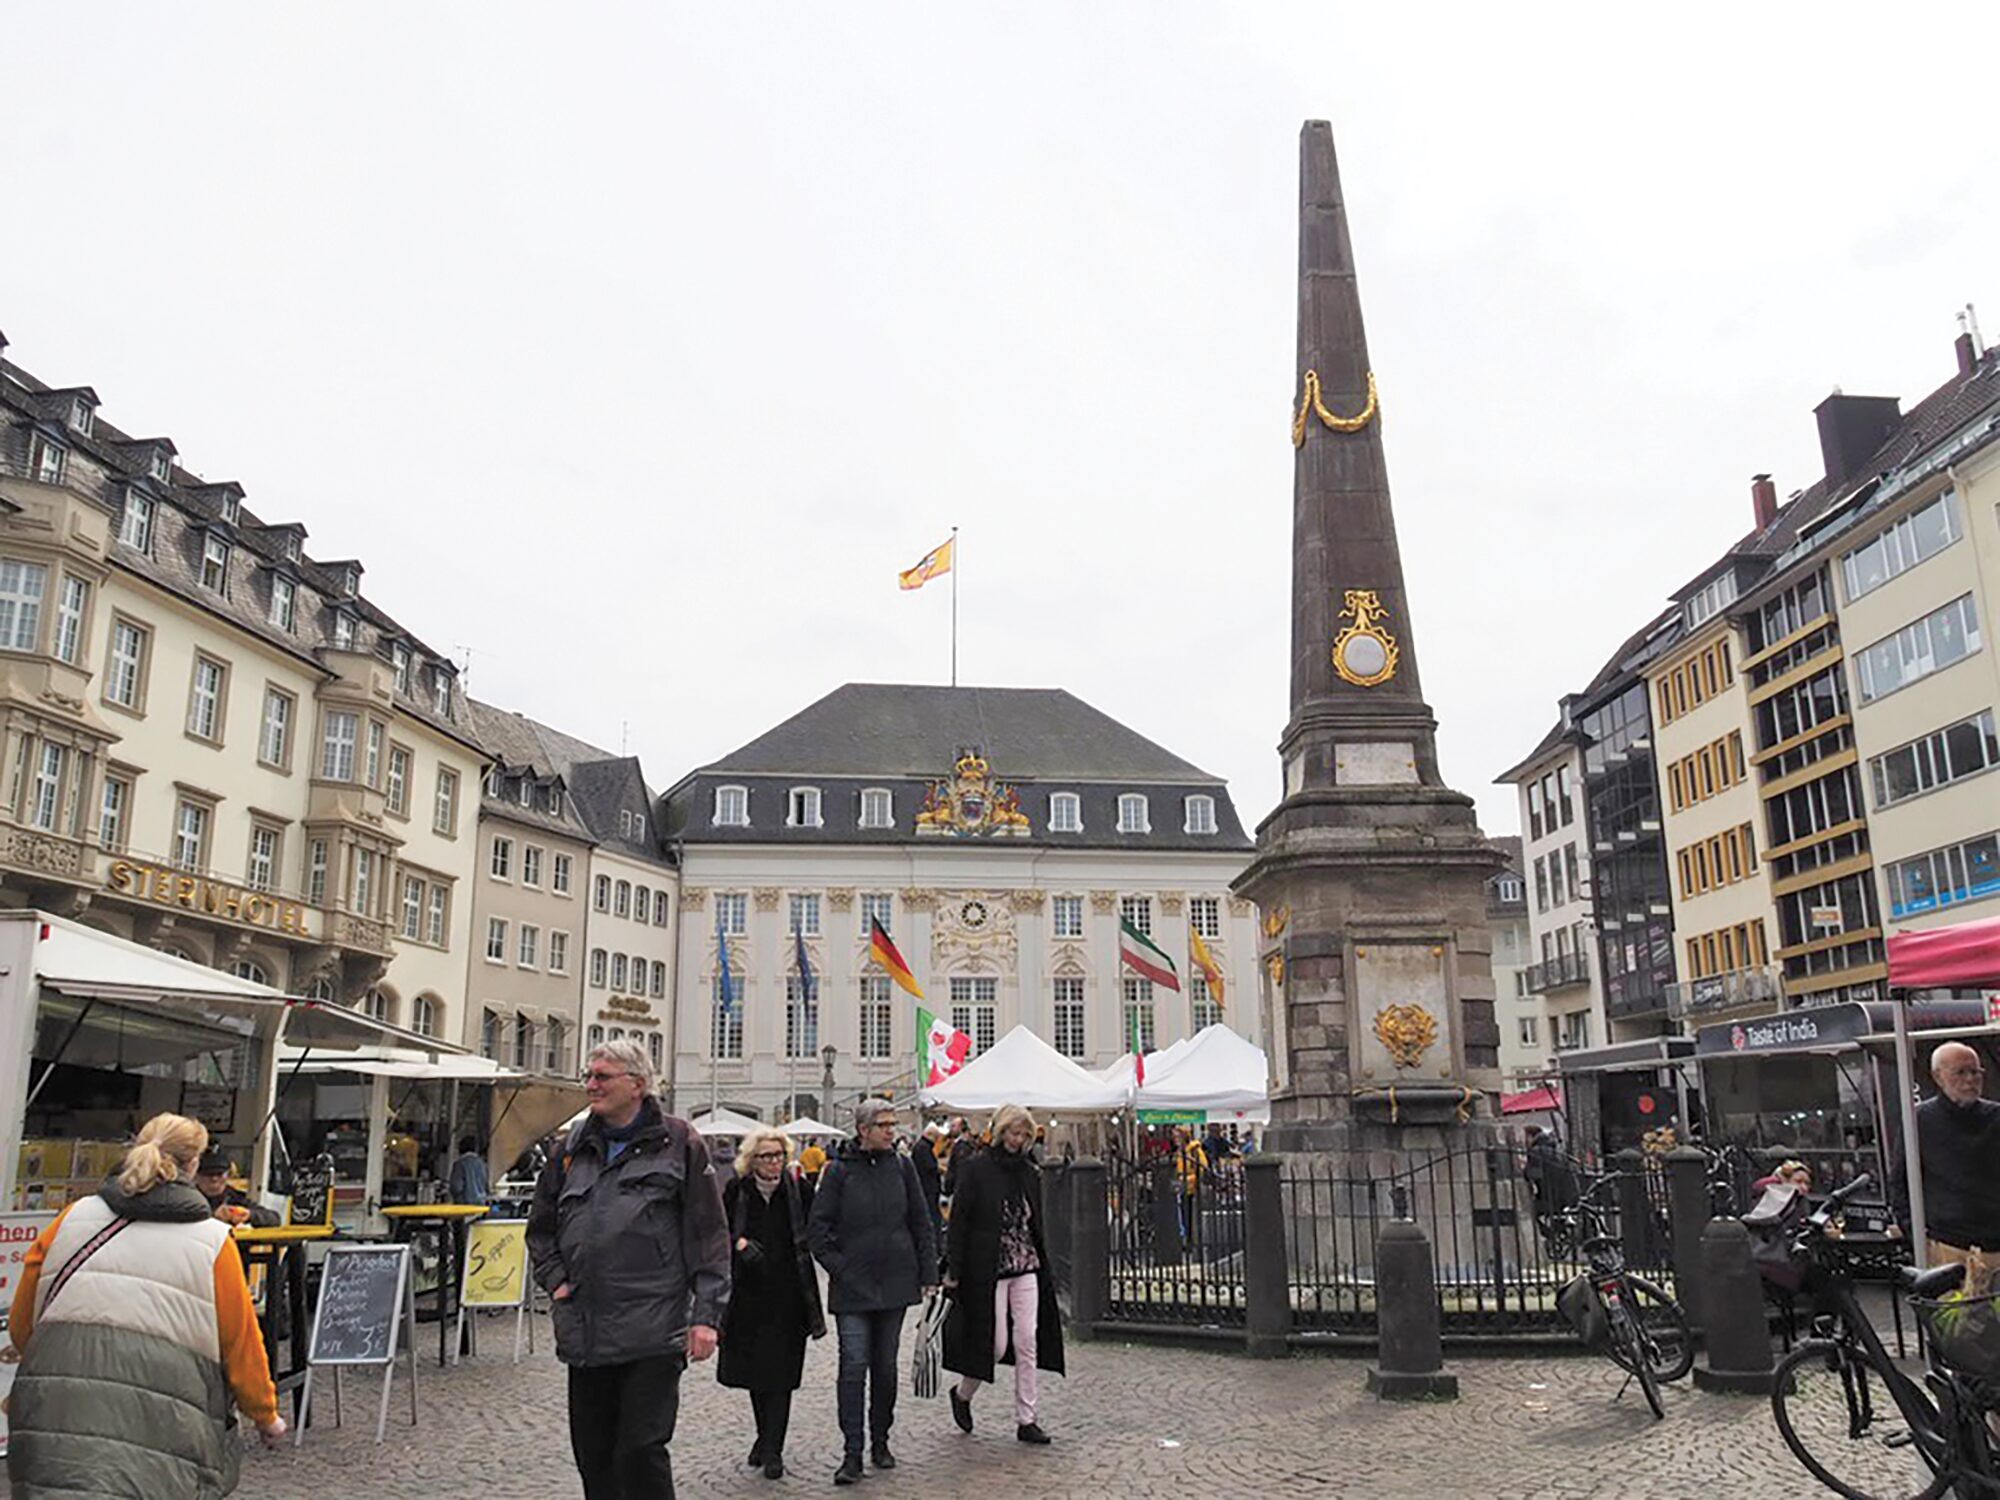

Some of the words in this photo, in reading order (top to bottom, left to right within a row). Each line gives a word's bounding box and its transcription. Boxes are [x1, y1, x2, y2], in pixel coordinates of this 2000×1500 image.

[109, 860, 309, 936] STERNHOTEL
[1746, 1026, 1774, 1046] Taste
[1775, 1020, 1788, 1042] of
[1788, 1018, 1818, 1041] India
